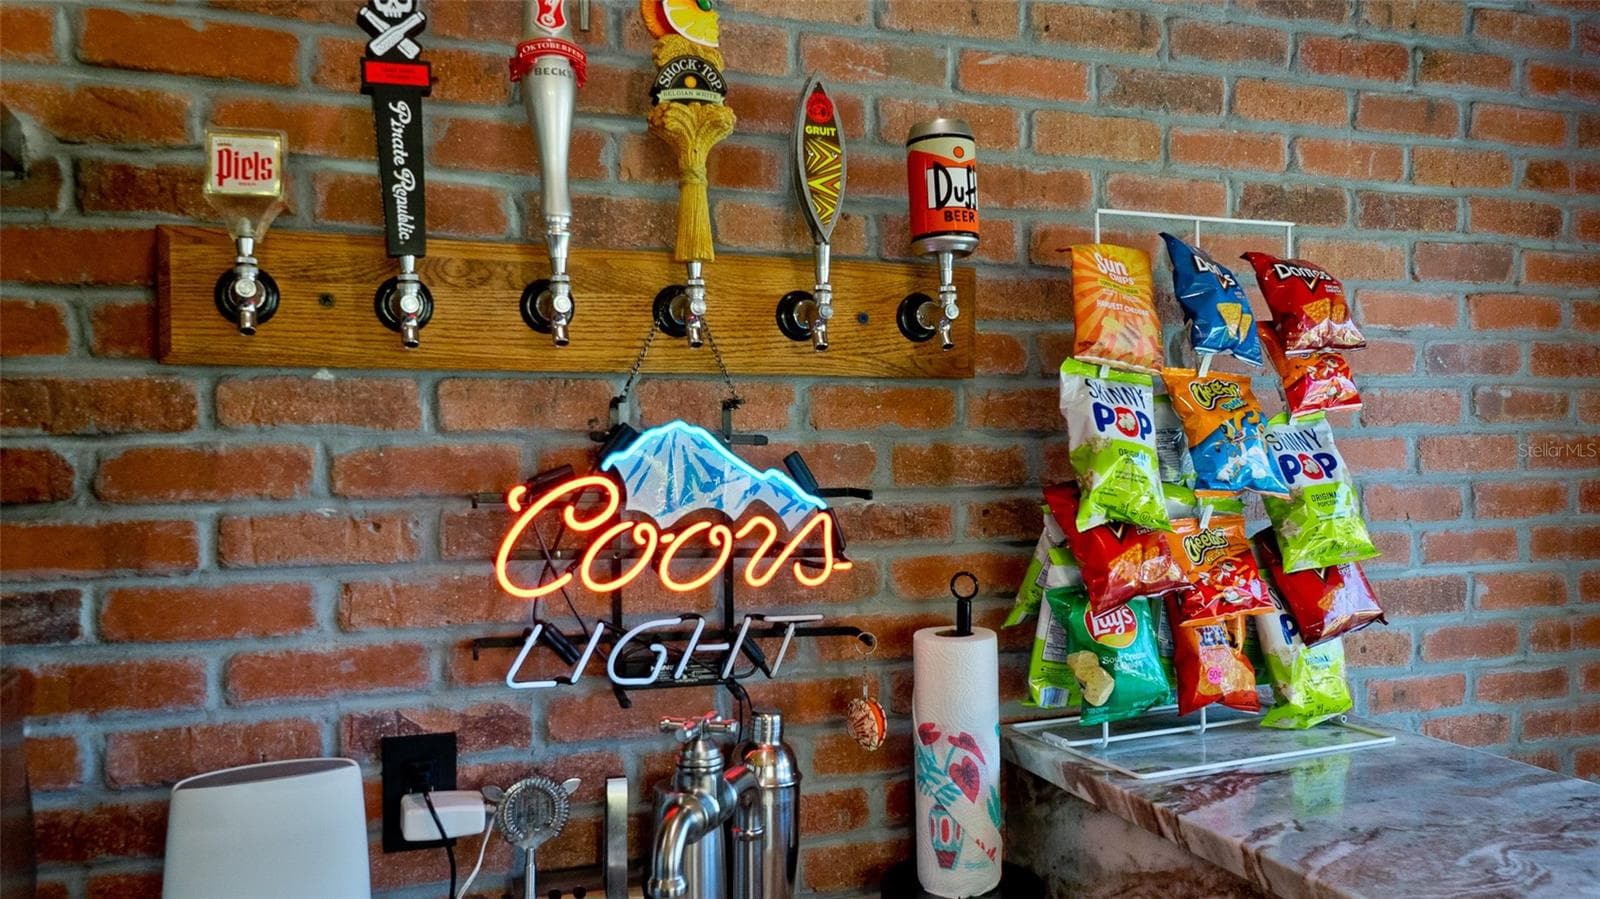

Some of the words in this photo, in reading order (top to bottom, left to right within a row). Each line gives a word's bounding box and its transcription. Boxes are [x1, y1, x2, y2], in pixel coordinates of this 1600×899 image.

[522, 42, 585, 61] OKTOBERFEST
[658, 58, 699, 88] SHOCK
[702, 63, 723, 90] TOP
[663, 90, 694, 98] BELGIAN
[388, 100, 412, 166] Pirate
[805, 125, 837, 137] GRUIT
[216, 148, 272, 187] Piels
[943, 210, 976, 222] BEER
[1093, 252, 1130, 277] Sun
[1108, 273, 1135, 286] CHIPS
[1092, 402, 1152, 441] POP
[1278, 452, 1338, 484] POP
[494, 476, 853, 599] Coors
[505, 613, 825, 690] LIGHT
